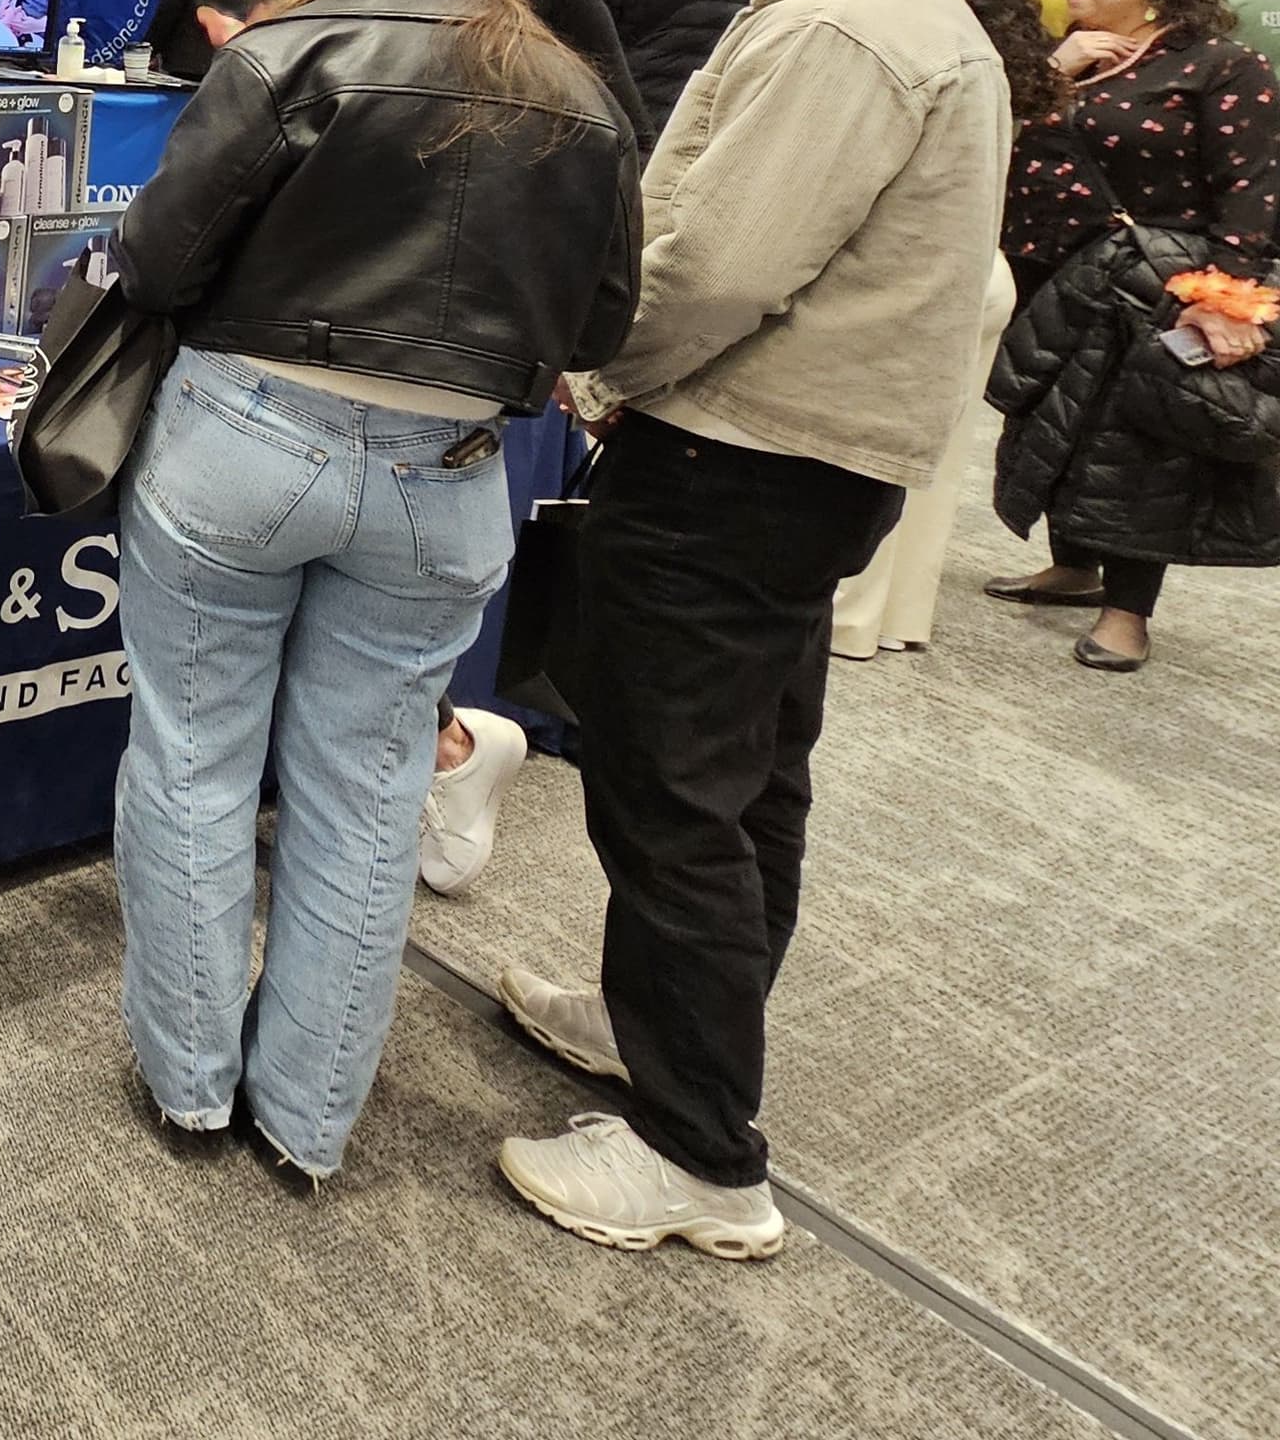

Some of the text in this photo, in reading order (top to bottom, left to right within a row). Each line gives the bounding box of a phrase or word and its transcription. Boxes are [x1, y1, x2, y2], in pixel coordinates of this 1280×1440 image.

[17, 95, 40, 111] glow
[33, 217, 70, 231] cleanse
[78, 215, 100, 230] glow
[0, 567, 42, 625] &
